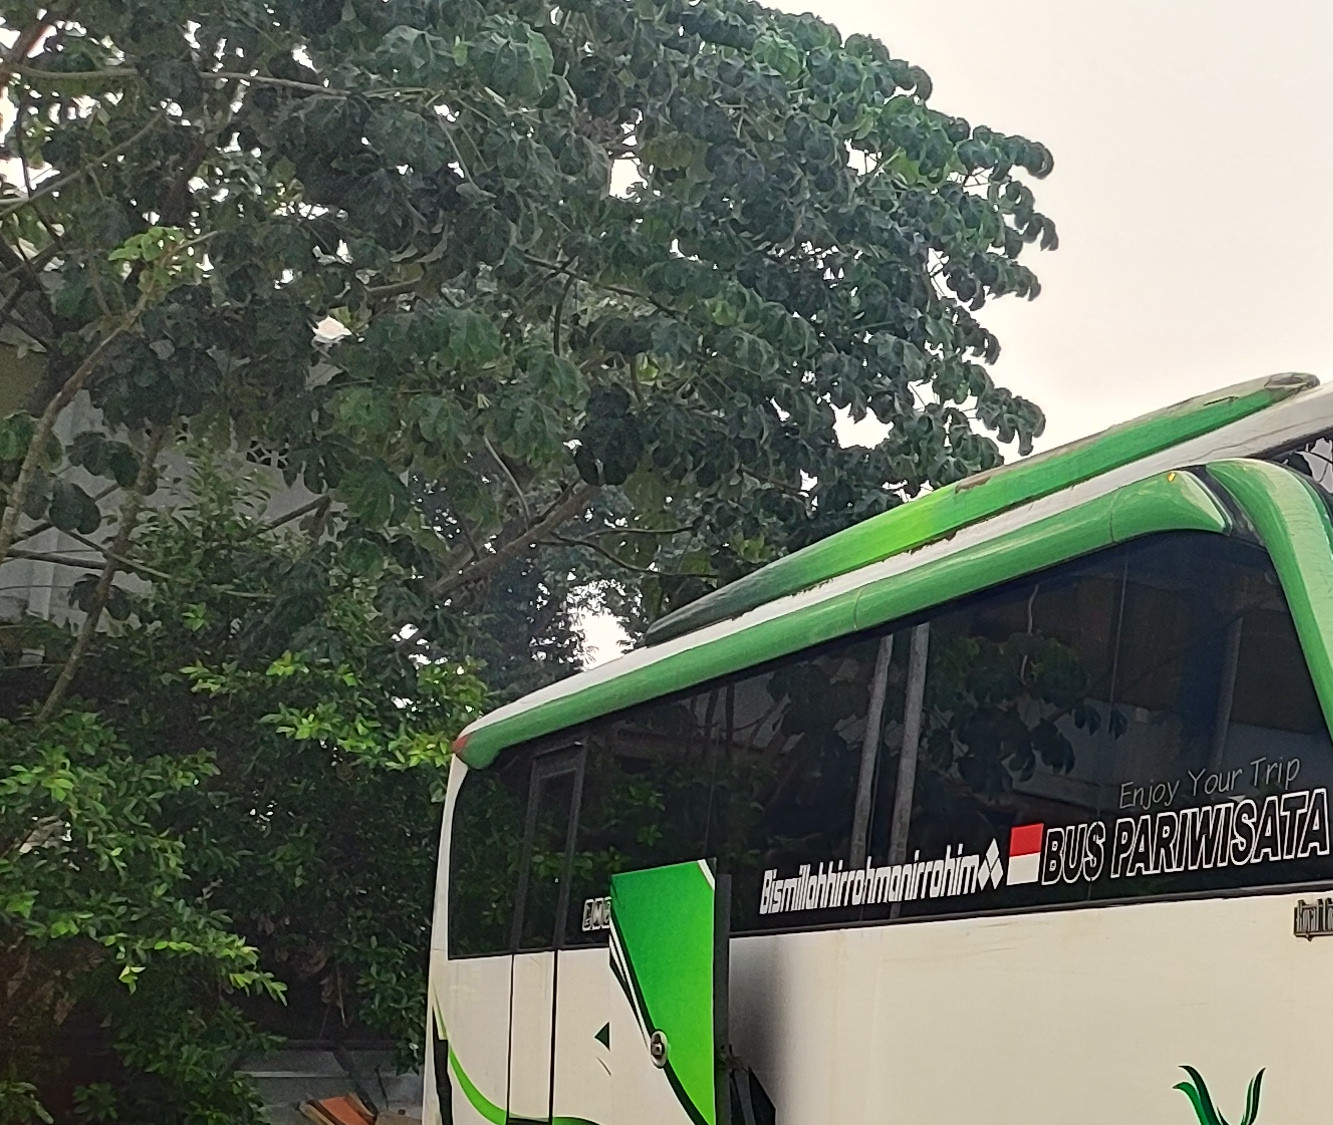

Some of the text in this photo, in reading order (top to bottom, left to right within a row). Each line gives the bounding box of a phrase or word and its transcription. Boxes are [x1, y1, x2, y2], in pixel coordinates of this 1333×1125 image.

[1118, 756, 1301, 812] Enjoy Your Trip
[1041, 787, 1331, 886] BUS PARIWISATA
